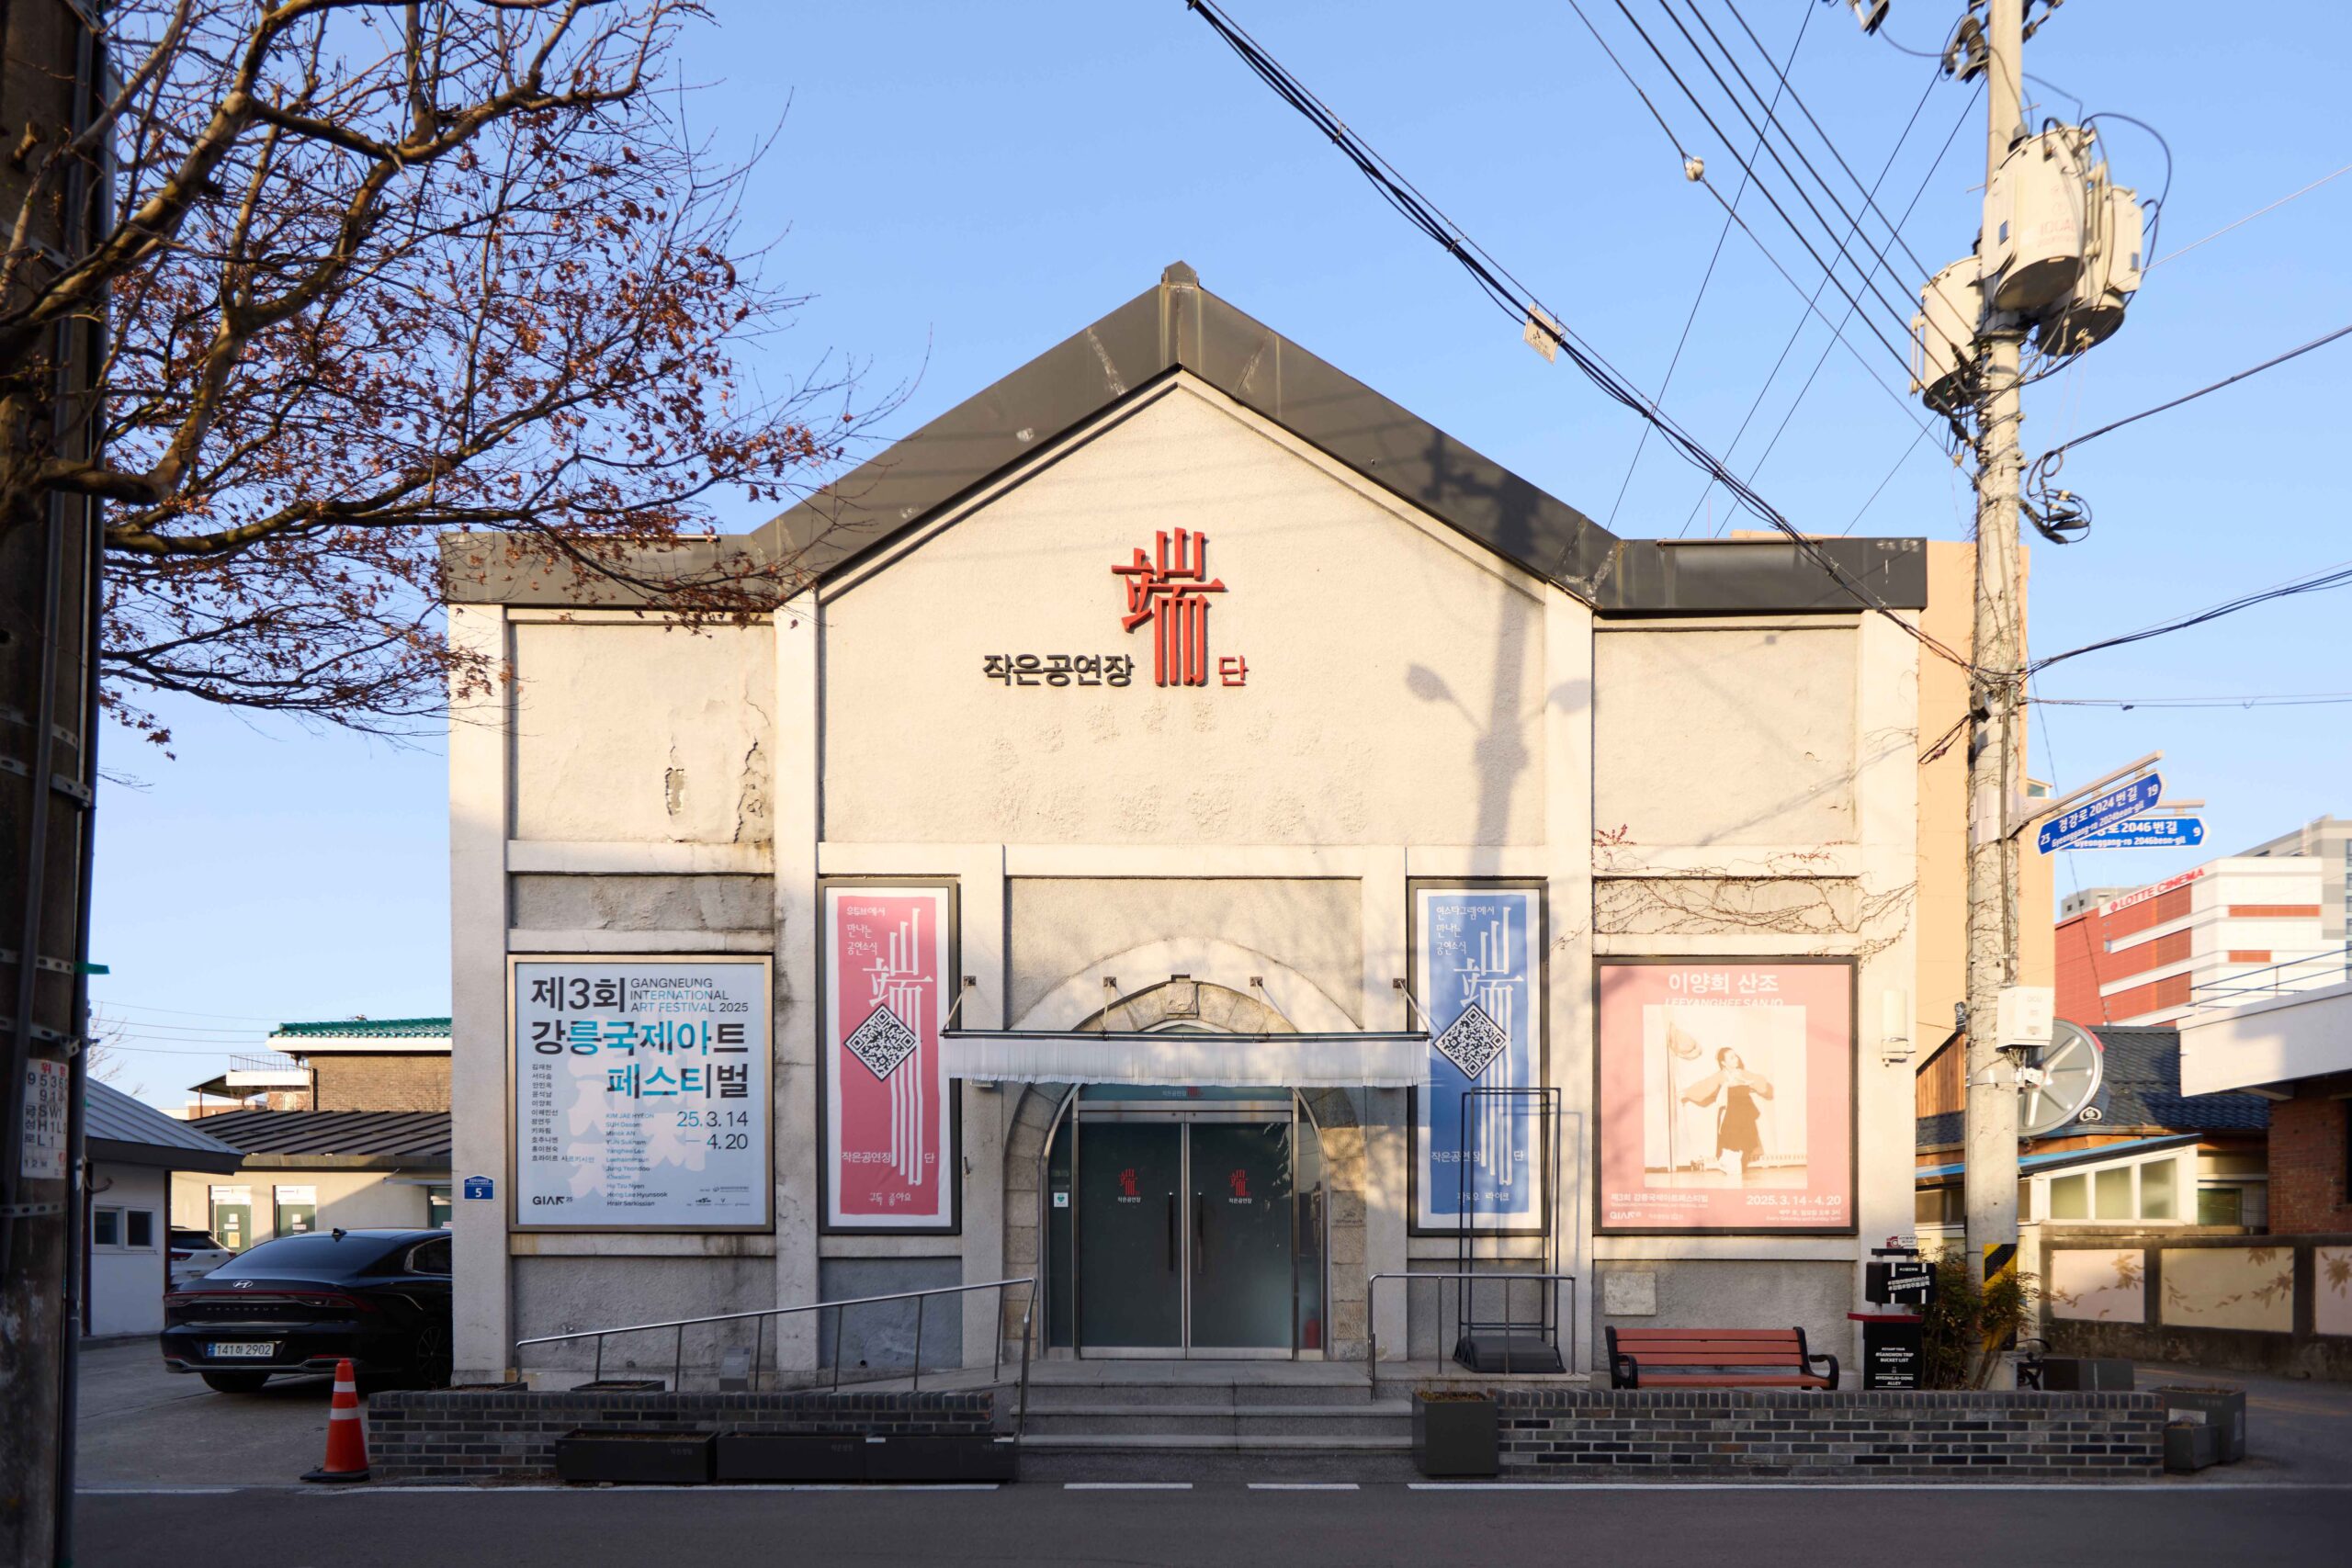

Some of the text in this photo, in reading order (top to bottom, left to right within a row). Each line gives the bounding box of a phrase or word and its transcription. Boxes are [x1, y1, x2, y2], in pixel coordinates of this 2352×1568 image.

[983, 654, 1135, 686] 작은공연장
[1219, 655, 1250, 686] 단
[2147, 784, 2158, 797] 19
[2052, 800, 2145, 848] Gyeonggang-ro 2024beon-gil
[2040, 832, 2051, 845] 23
[2192, 827, 2201, 837] 9
[2133, 835, 2187, 846] 2046beon-gil
[2120, 868, 2205, 908] LOTTE CINEMA
[846, 906, 886, 917] 유튜브에서
[1436, 906, 1495, 920] 인스타그램에서
[846, 923, 872, 938] 만나는
[1436, 923, 1462, 938] 만나는
[846, 941, 877, 956] 공연소식
[1436, 941, 1466, 956] 공연소식
[630, 978, 713, 988] GANGNEUNG
[1668, 972, 1780, 995] 이양희 산조
[530, 976, 626, 1012] 제3회
[630, 990, 729, 1000] INTERNATIONAL
[630, 1002, 749, 1012] ART FESTIVAL 2025
[530, 1020, 749, 1056] 강릉국제아트
[606, 1063, 749, 1099] 페스티벌
[842, 1151, 935, 1164] 작은공연장 단
[1514, 1150, 1525, 1161] 단
[475, 1188, 482, 1198] 5
[869, 1192, 912, 1206] 구독 좋아요
[1747, 1195, 1842, 1205] 2025. 3. 14 4. 20
[245, 1345, 272, 1355] 2902
